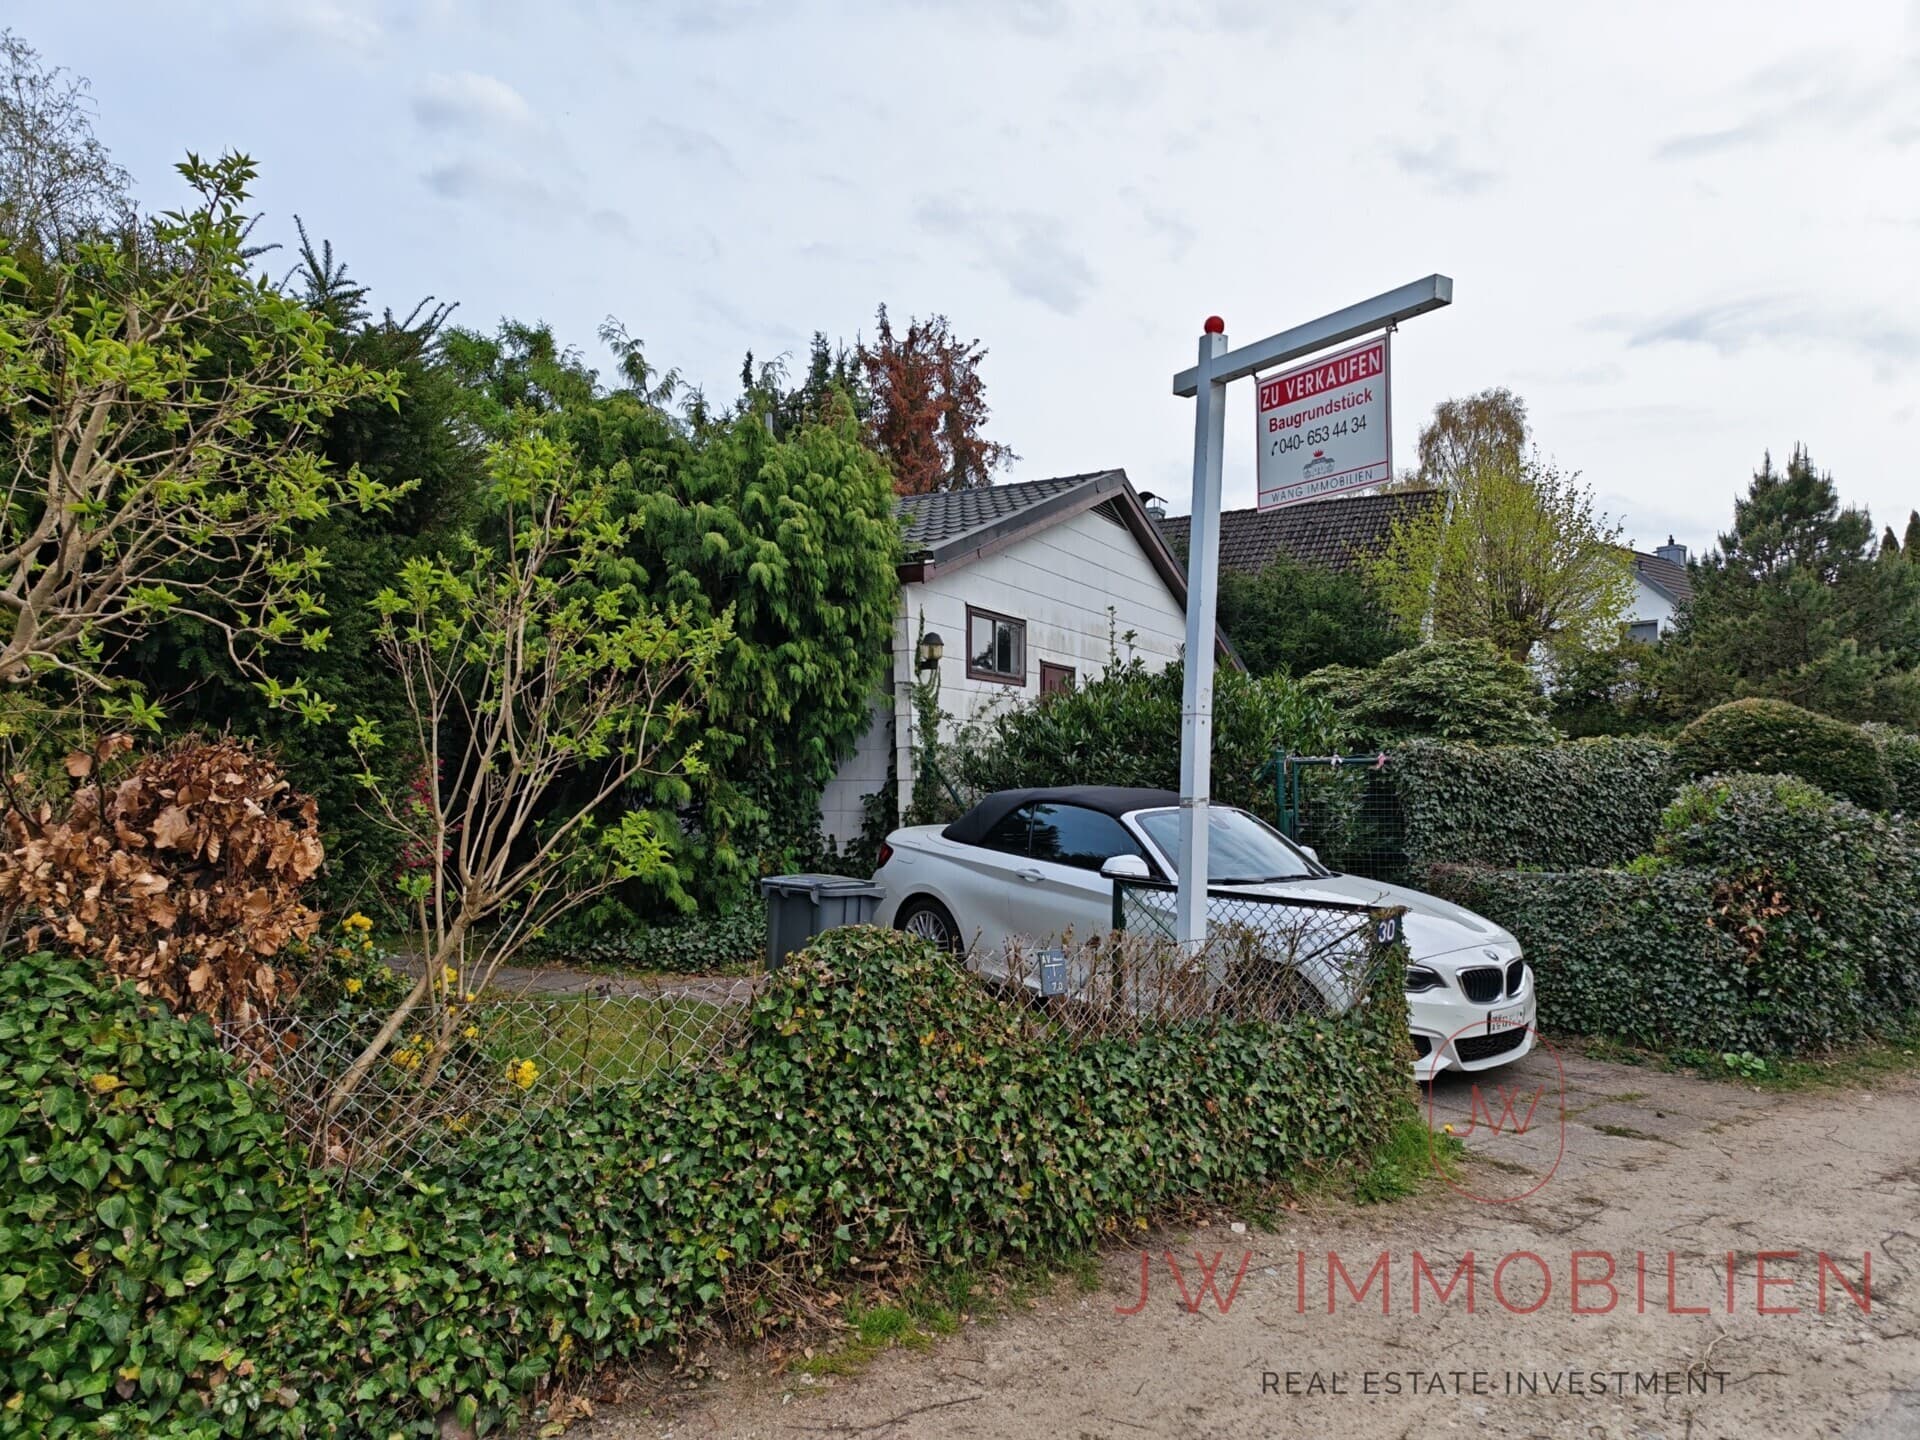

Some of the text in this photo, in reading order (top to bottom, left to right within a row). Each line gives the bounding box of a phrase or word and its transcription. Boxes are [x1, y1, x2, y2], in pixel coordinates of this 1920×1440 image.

[1262, 349, 1380, 409] ZU VERKAUFEN
[1269, 387, 1373, 433] Baugrundstück
[1279, 414, 1367, 454] 040- 653 44 34
[1271, 469, 1374, 502] WANG IMMOBILIEN
[1378, 919, 1395, 943] 30
